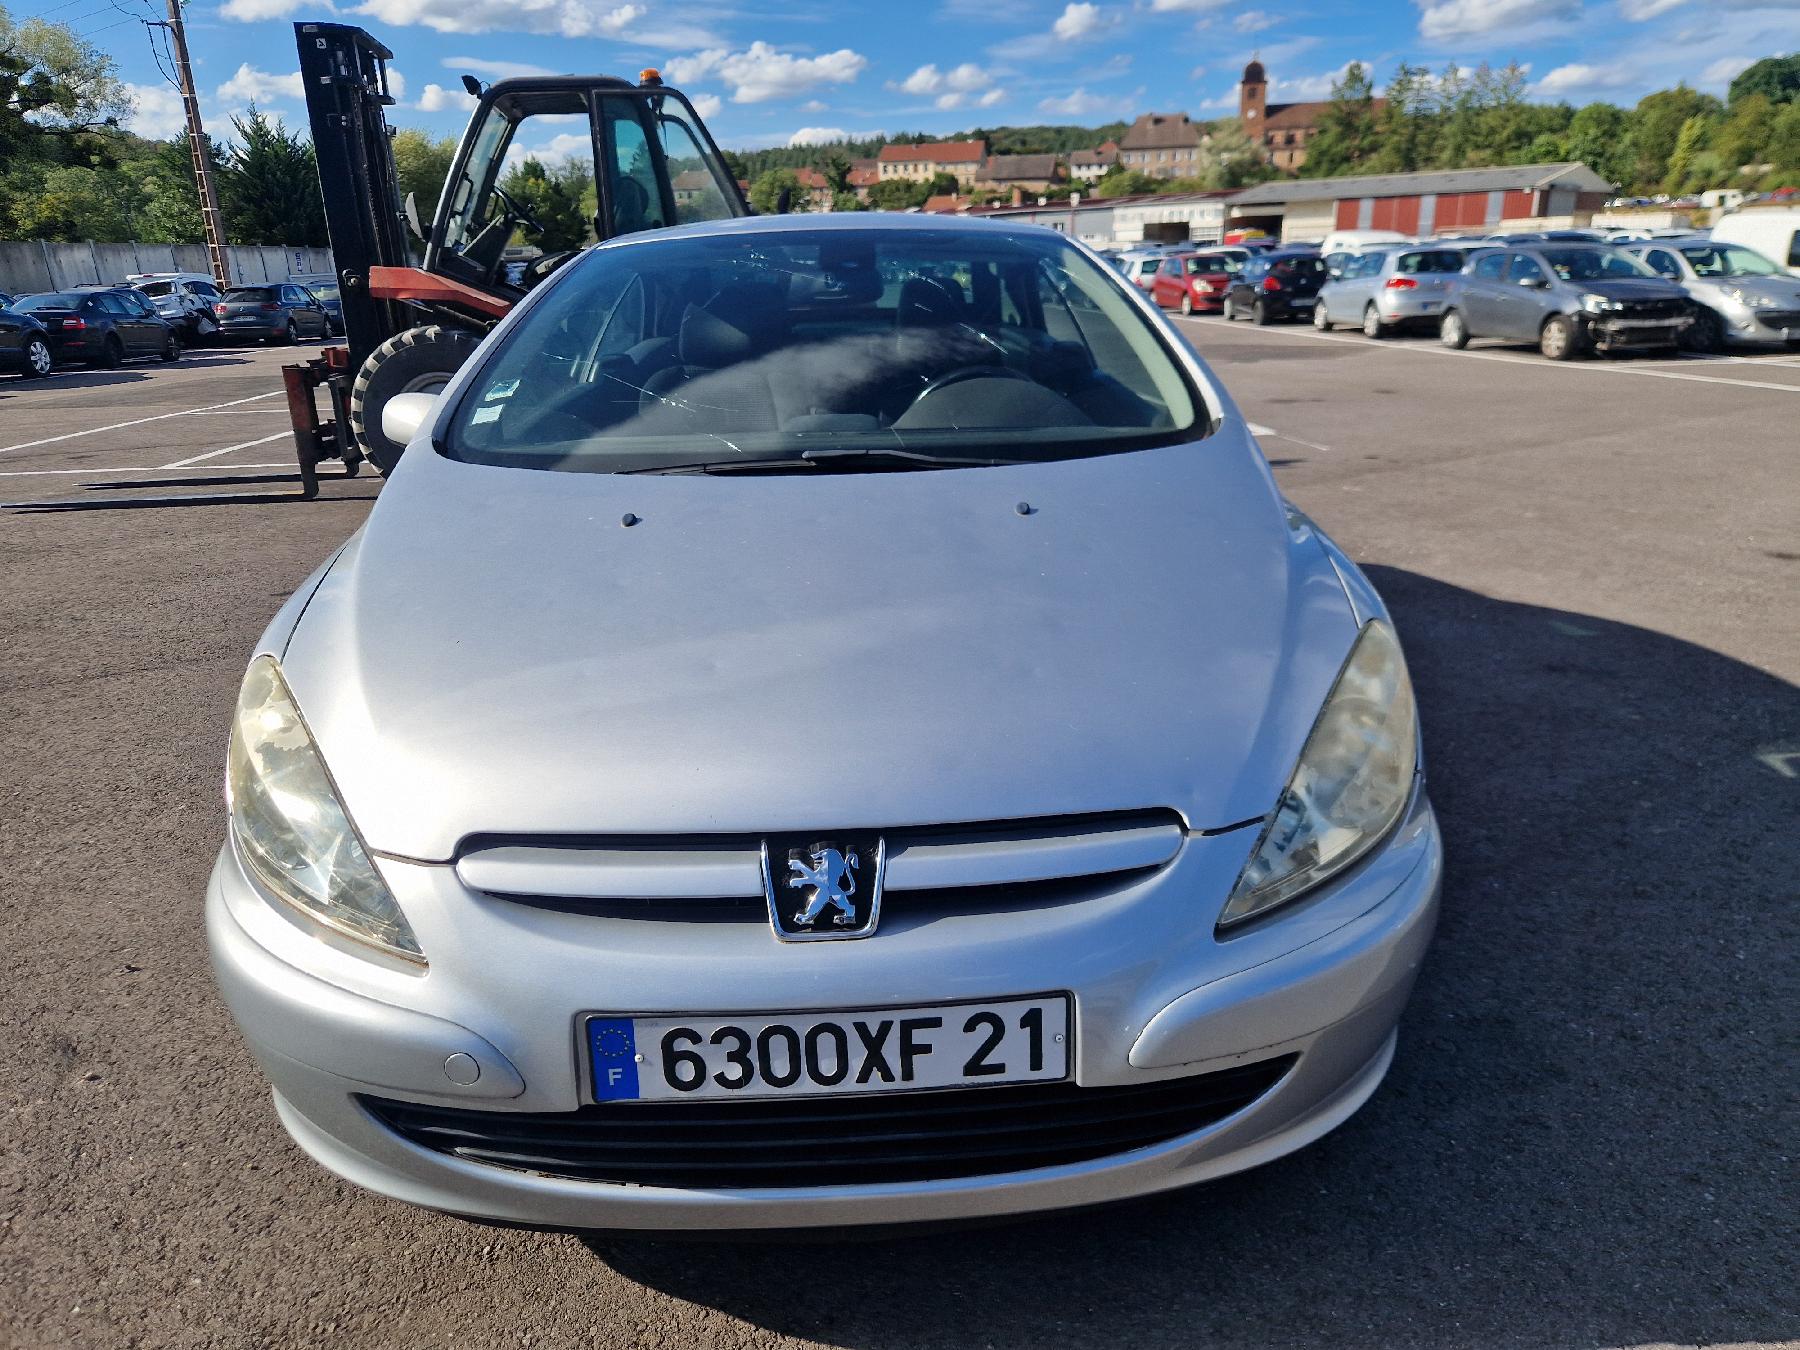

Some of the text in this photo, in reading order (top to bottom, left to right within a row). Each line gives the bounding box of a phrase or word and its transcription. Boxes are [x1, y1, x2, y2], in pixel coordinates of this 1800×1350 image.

[660, 1007, 1043, 1092] 6300XF 21
[608, 1068, 623, 1086] F
